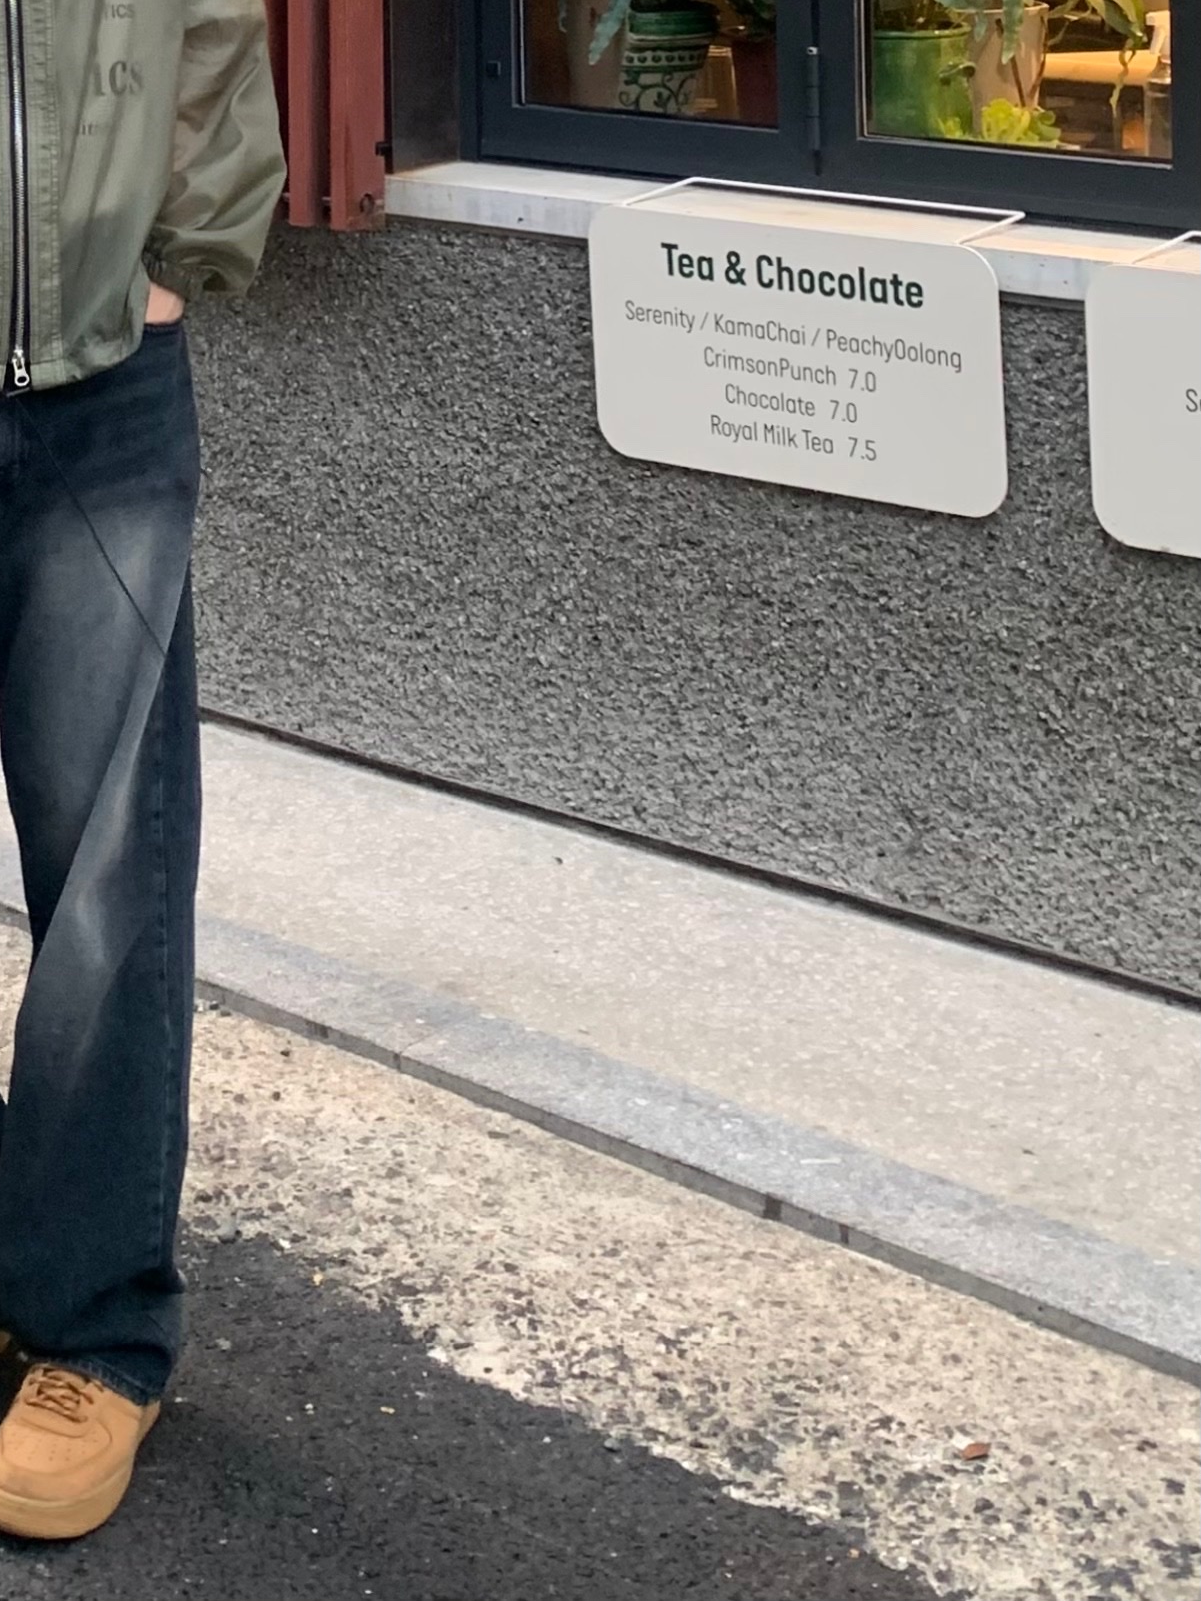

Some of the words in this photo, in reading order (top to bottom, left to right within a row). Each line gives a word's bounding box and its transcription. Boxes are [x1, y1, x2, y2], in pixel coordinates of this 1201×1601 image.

[661, 243, 714, 281] Tea
[725, 251, 746, 285] &
[757, 255, 923, 308] Chocolate
[626, 300, 695, 333] Serenity
[700, 312, 709, 330] /
[714, 314, 805, 345] KamaChai
[811, 328, 820, 346] /
[827, 329, 961, 373] PeachyOolong
[704, 347, 836, 385] CrimsonPunch
[849, 369, 876, 392] 7.0
[726, 384, 815, 416] Chocolate
[830, 400, 857, 423] 7.0
[1185, 388, 1201, 413] S
[711, 415, 757, 442] Royal
[764, 424, 797, 447] Milk
[802, 430, 833, 453] Tea
[849, 437, 876, 461] 7.5
